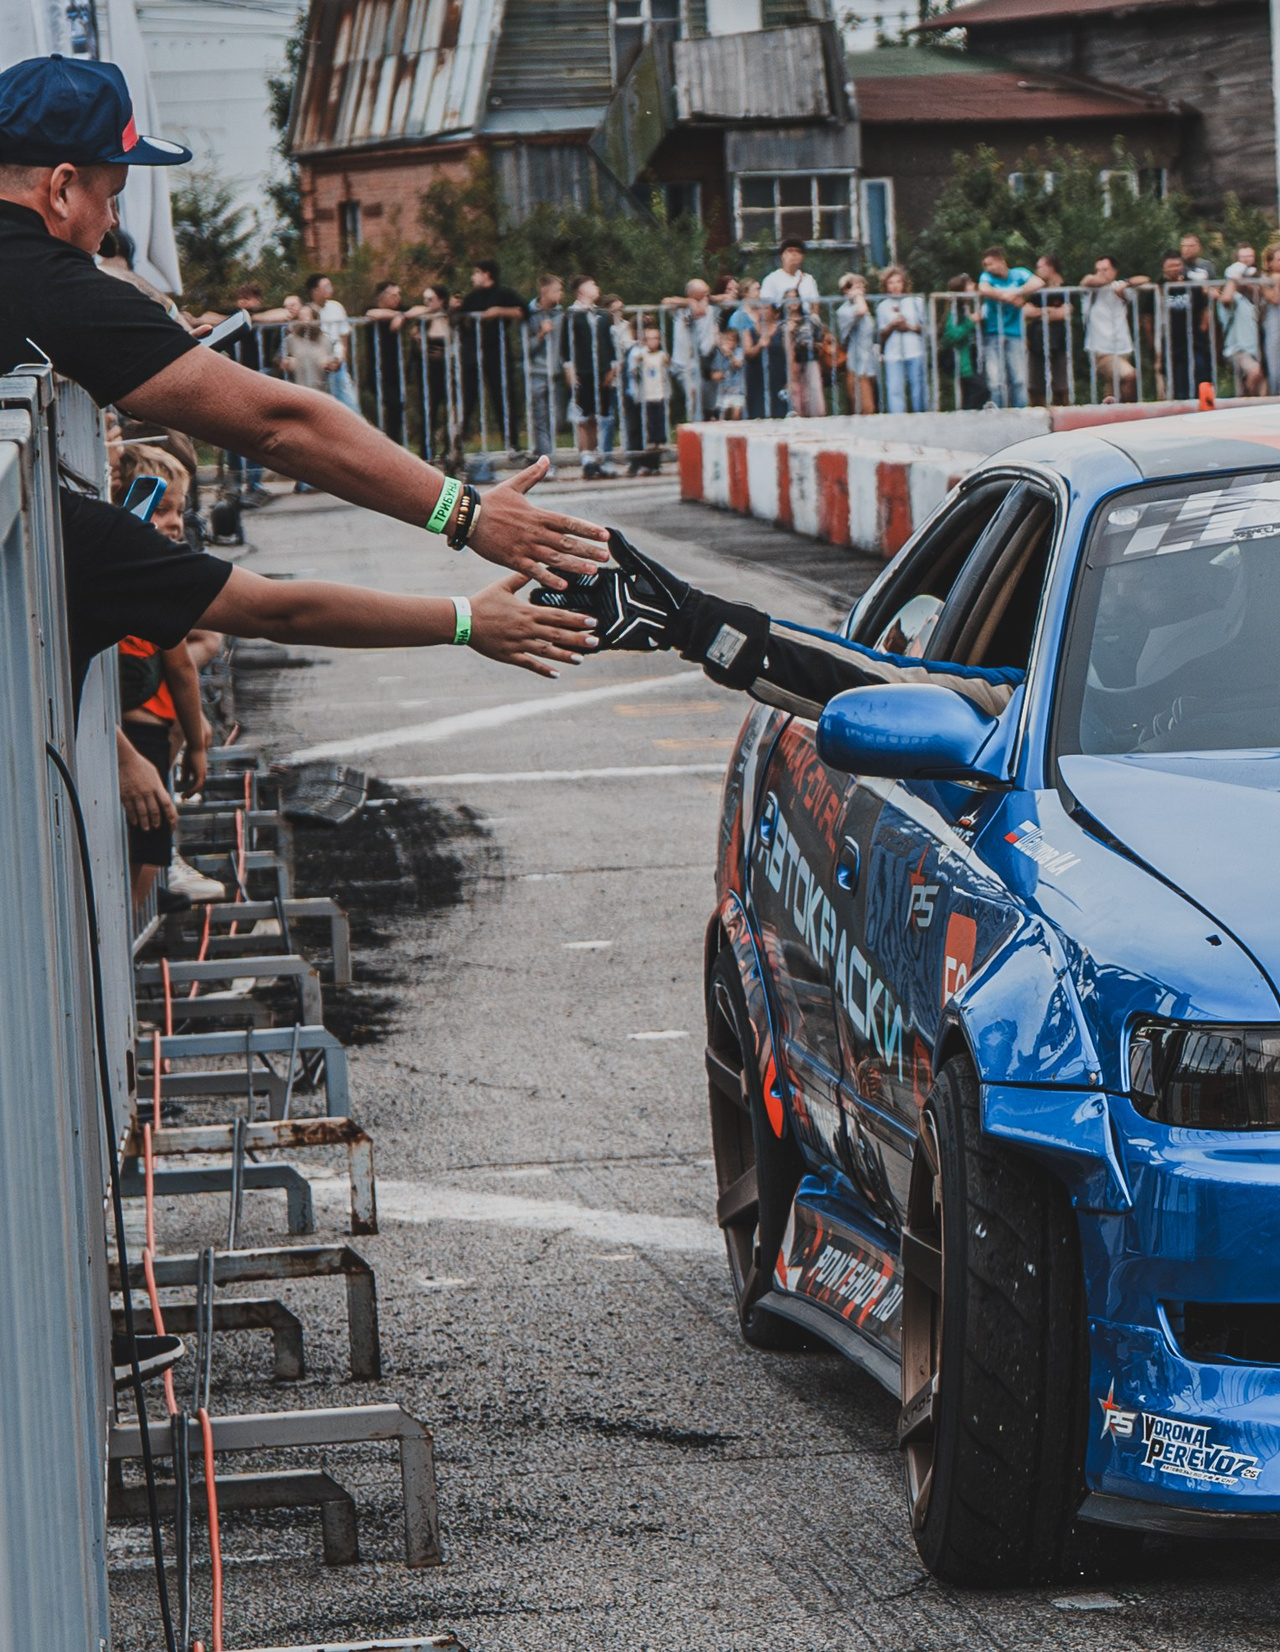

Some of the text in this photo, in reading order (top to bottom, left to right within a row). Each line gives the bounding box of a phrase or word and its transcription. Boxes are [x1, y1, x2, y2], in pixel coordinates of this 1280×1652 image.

[433, 481, 459, 523] ТРИБУНА
[808, 1244, 904, 1322] PONTSHOP.RU
[1144, 1413, 1206, 1449] VORONA
[1147, 1438, 1257, 1478] PEREVOZ
